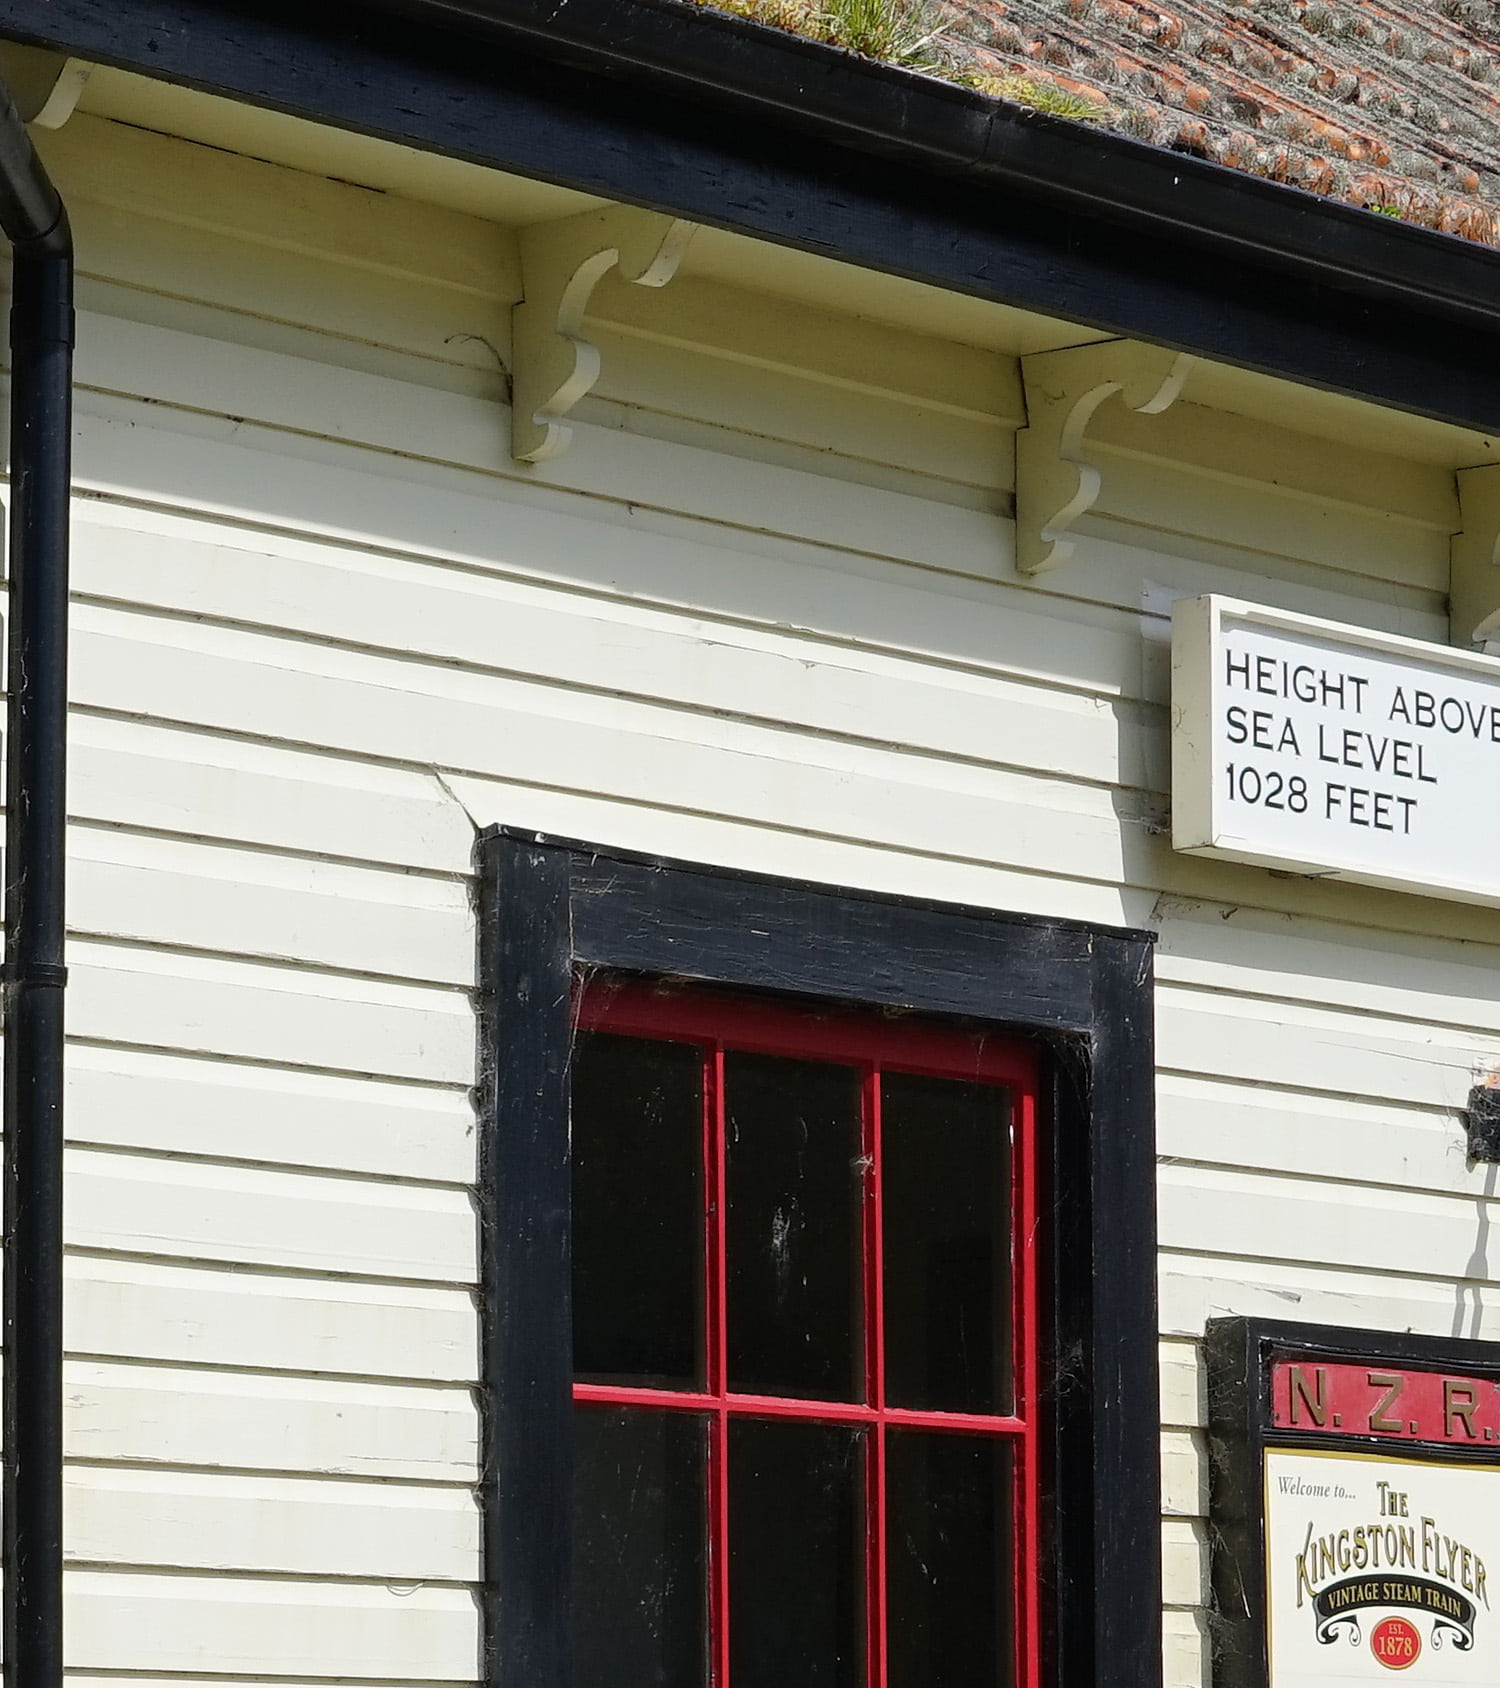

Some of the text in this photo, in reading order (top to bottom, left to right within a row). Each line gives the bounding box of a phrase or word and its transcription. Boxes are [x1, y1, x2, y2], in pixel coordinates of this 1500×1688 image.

[1224, 648, 1368, 715] HEIGHT
[1226, 705, 1437, 786] SEA LEVEL
[1226, 763, 1418, 836] 1028 FEET
[1278, 1476, 1356, 1501] Welcome to...
[1377, 1481, 1409, 1517] THE
[1296, 1516, 1491, 1612] KINGSTON FLYER
[1327, 1582, 1463, 1618] VINTAGE STEAM TRAIN
[1379, 1635, 1413, 1657] 1878
